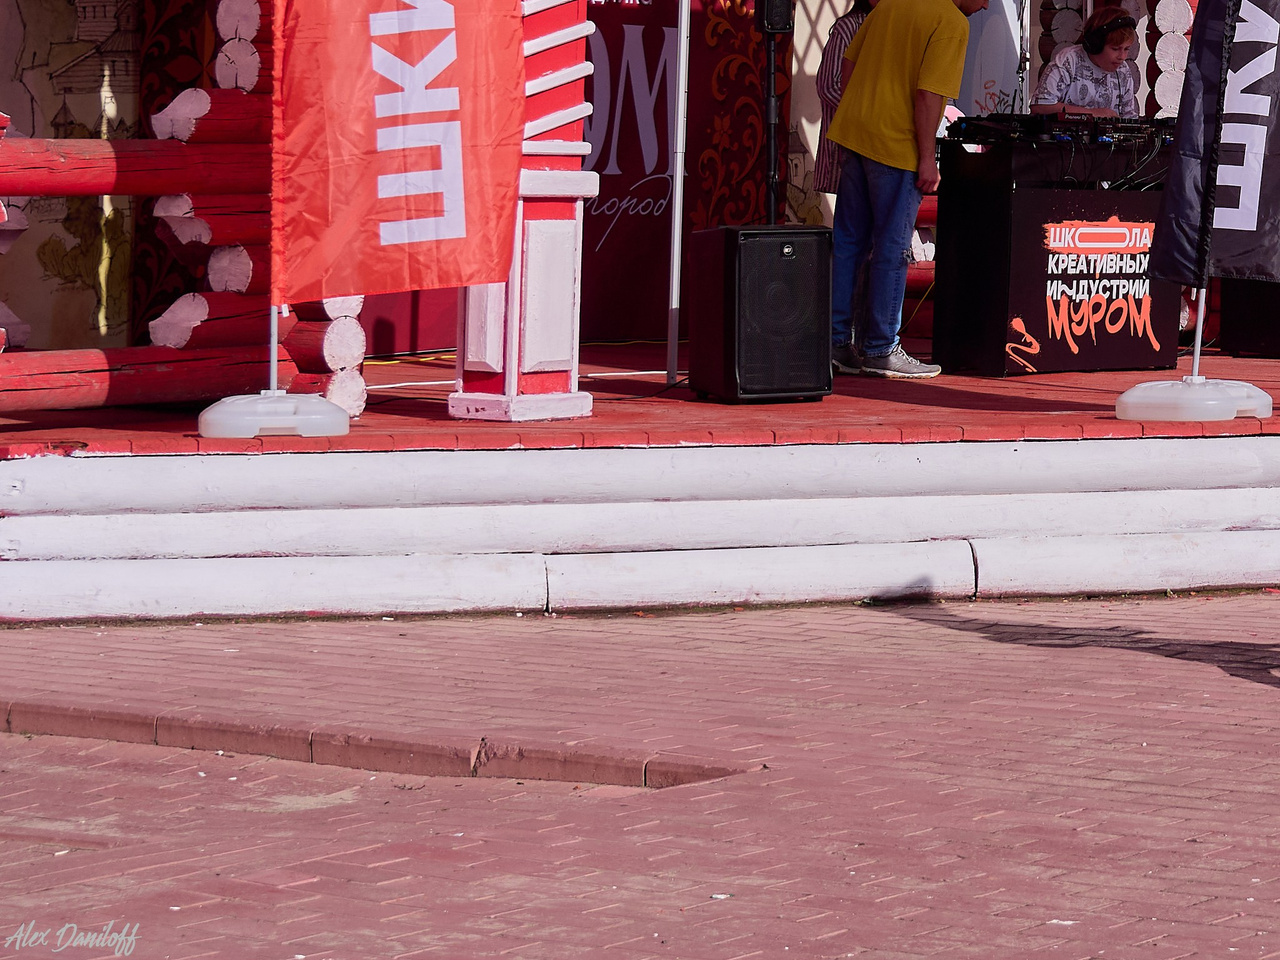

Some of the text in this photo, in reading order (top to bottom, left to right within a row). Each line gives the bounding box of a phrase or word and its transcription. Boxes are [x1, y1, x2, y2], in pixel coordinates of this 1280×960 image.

[1049, 227, 1152, 248] ШКОЛА
[1047, 253, 1150, 275] КРЕАТИВНЫХ
[1046, 275, 1151, 302] ИНДУСТРИЙ
[1046, 293, 1161, 355] МУРОМ
